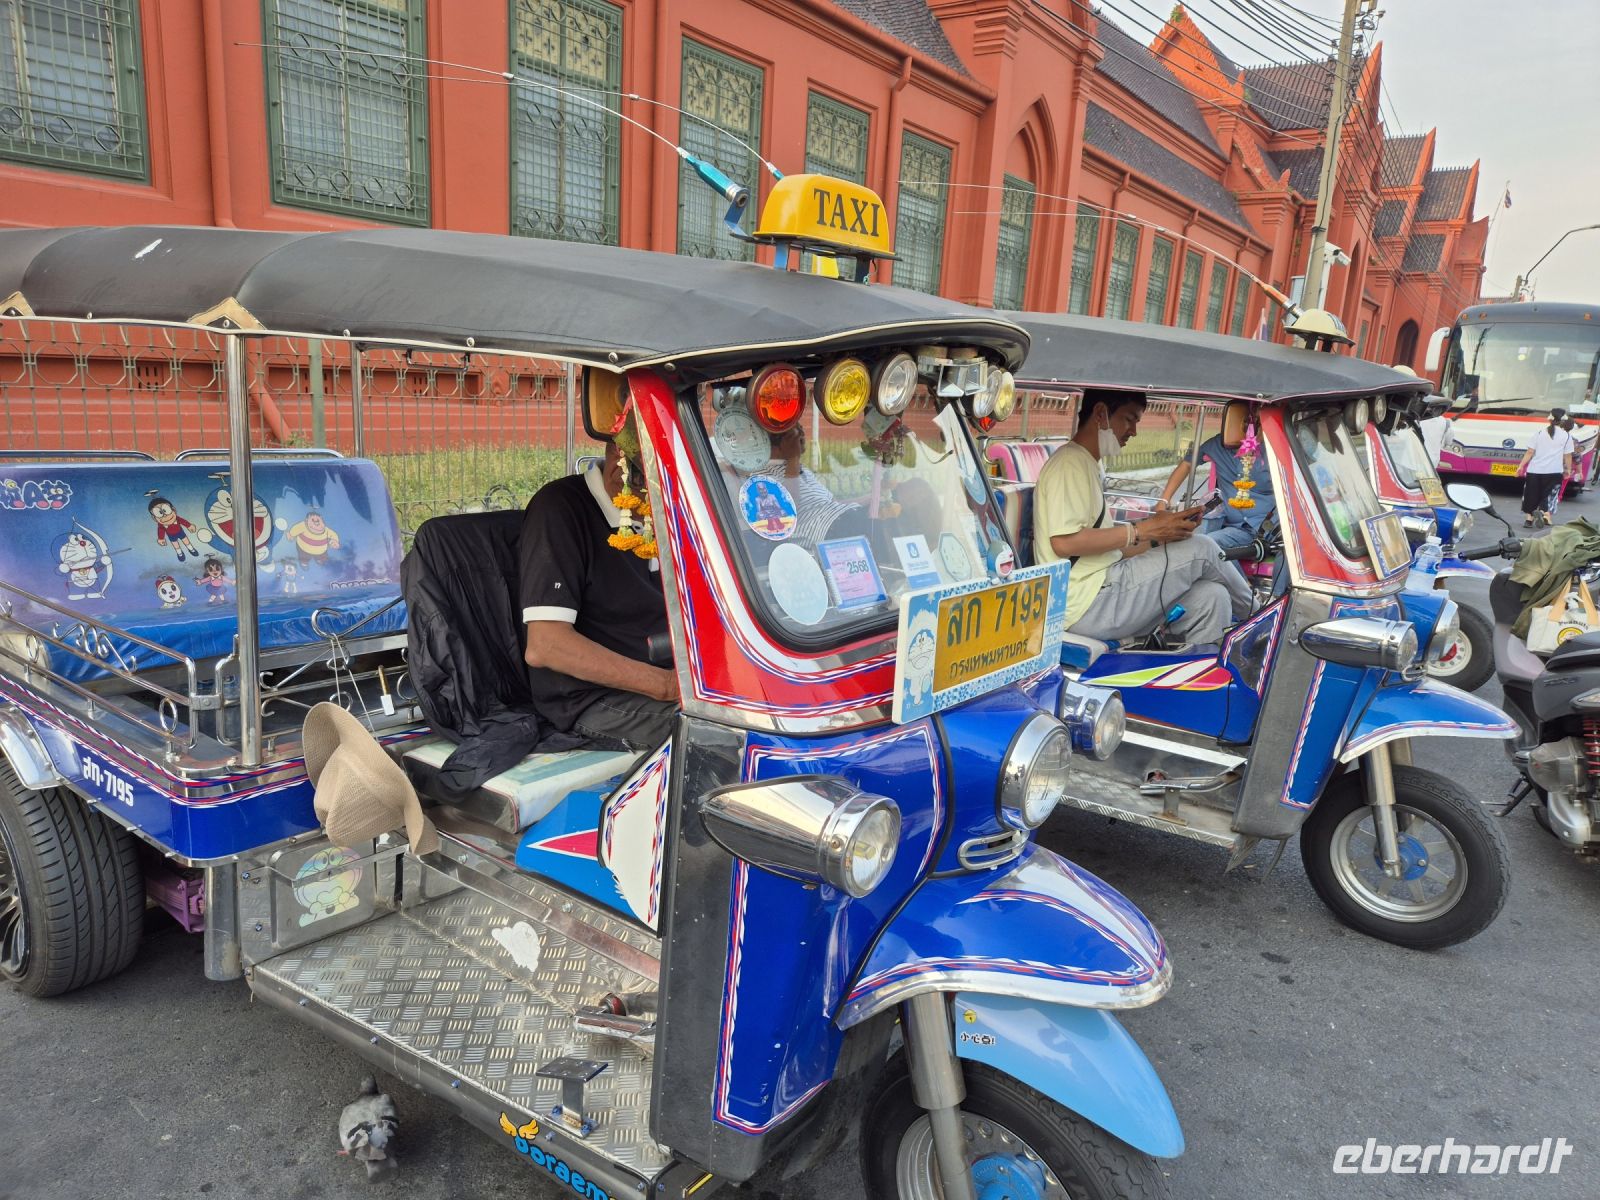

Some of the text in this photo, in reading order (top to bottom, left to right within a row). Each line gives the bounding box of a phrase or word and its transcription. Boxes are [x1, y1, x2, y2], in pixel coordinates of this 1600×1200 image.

[814, 188, 880, 236] TAXI
[946, 581, 1045, 648] สก 7195
[949, 638, 1029, 681] กรุงเทพมหานคร
